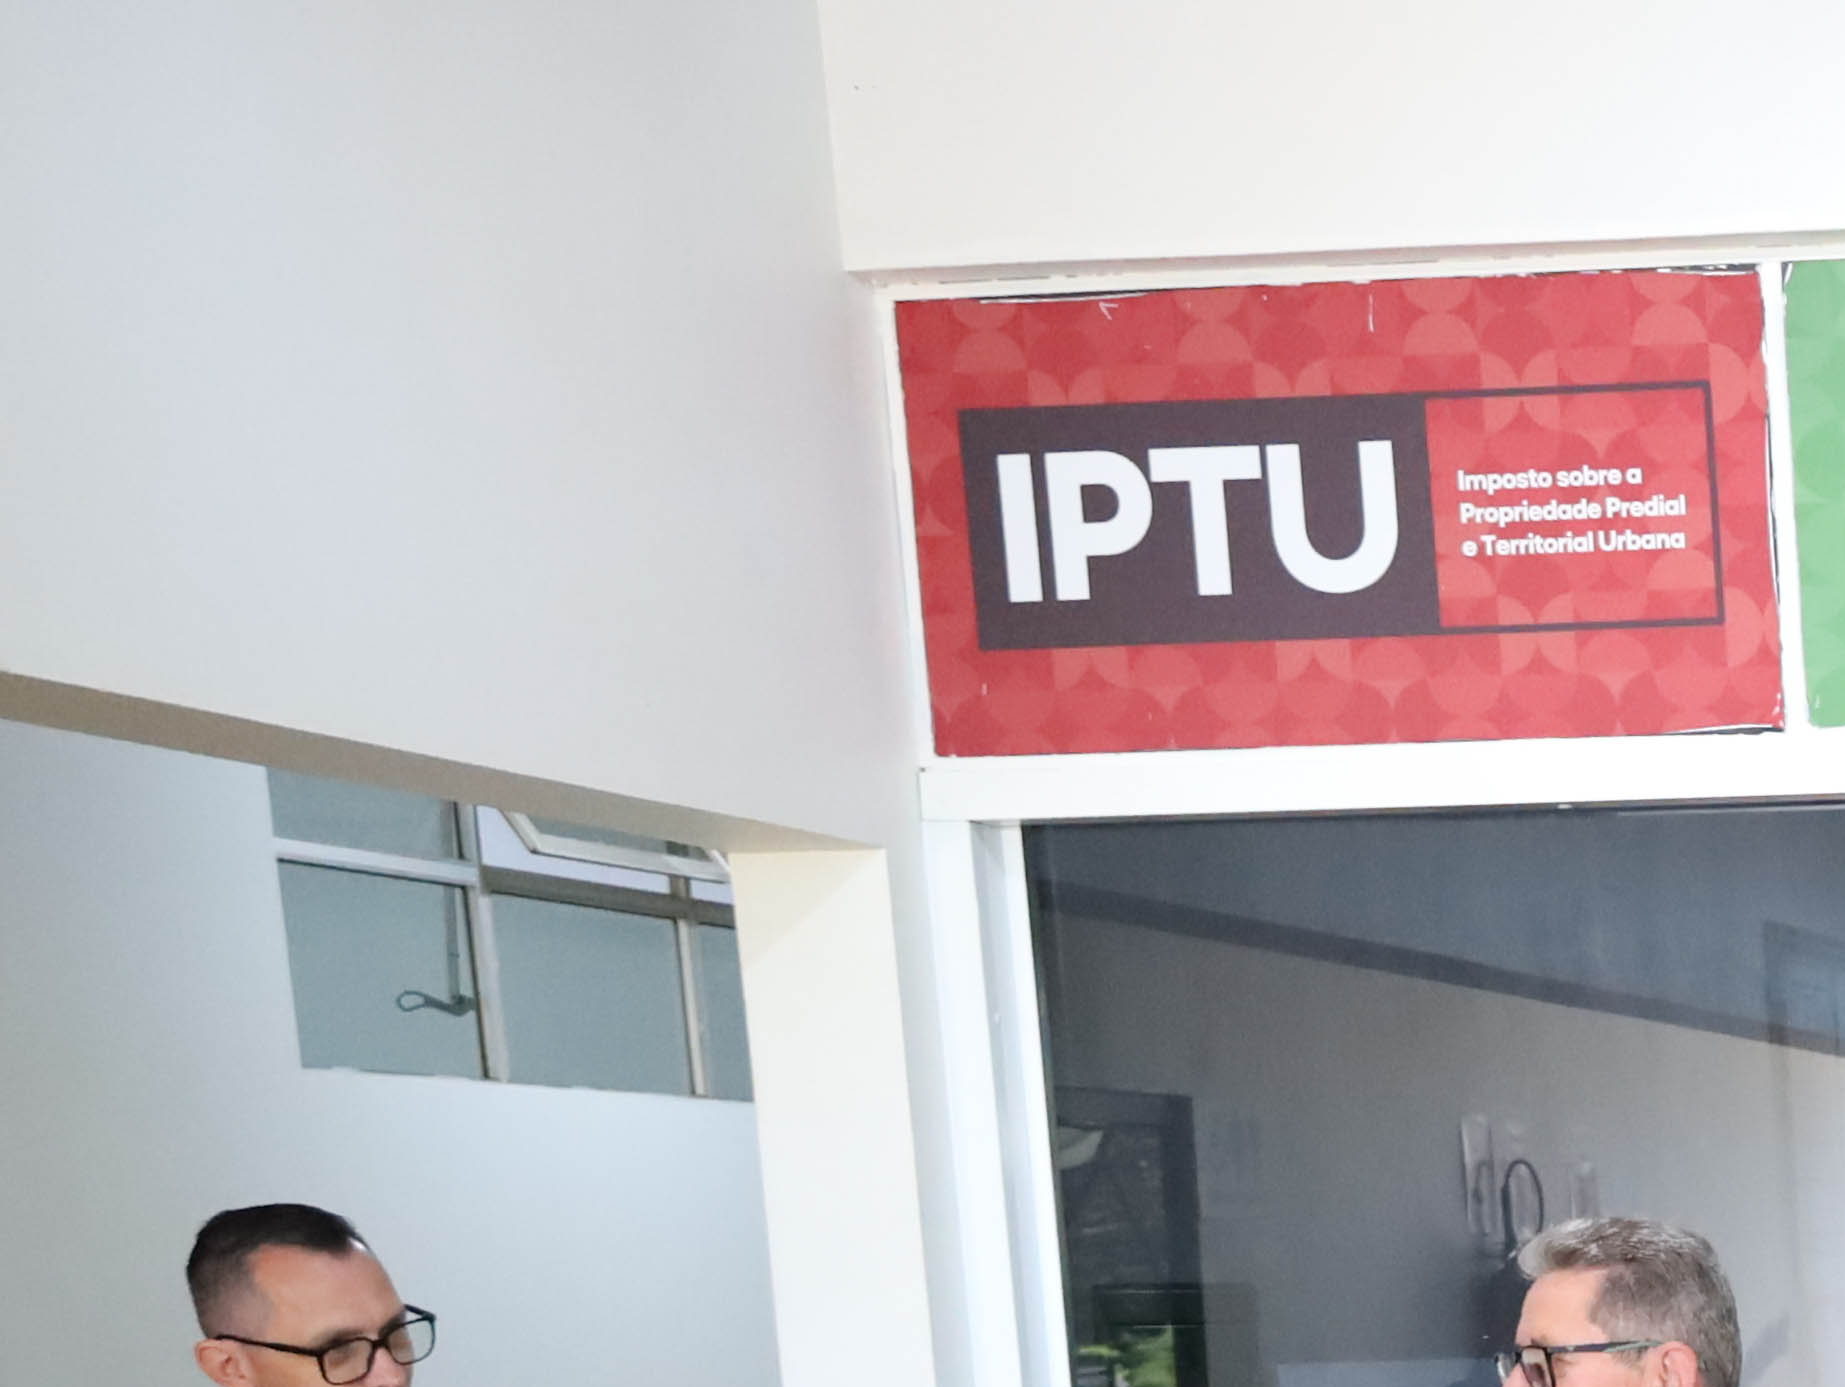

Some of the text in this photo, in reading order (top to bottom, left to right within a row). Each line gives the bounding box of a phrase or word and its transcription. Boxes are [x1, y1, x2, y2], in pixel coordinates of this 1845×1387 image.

[1457, 464, 1643, 495] Imposto sobre a
[996, 440, 1400, 603] IPTU
[1459, 493, 1687, 528] Propriedade Predial
[1461, 529, 1687, 556] e Territorial Urbana
